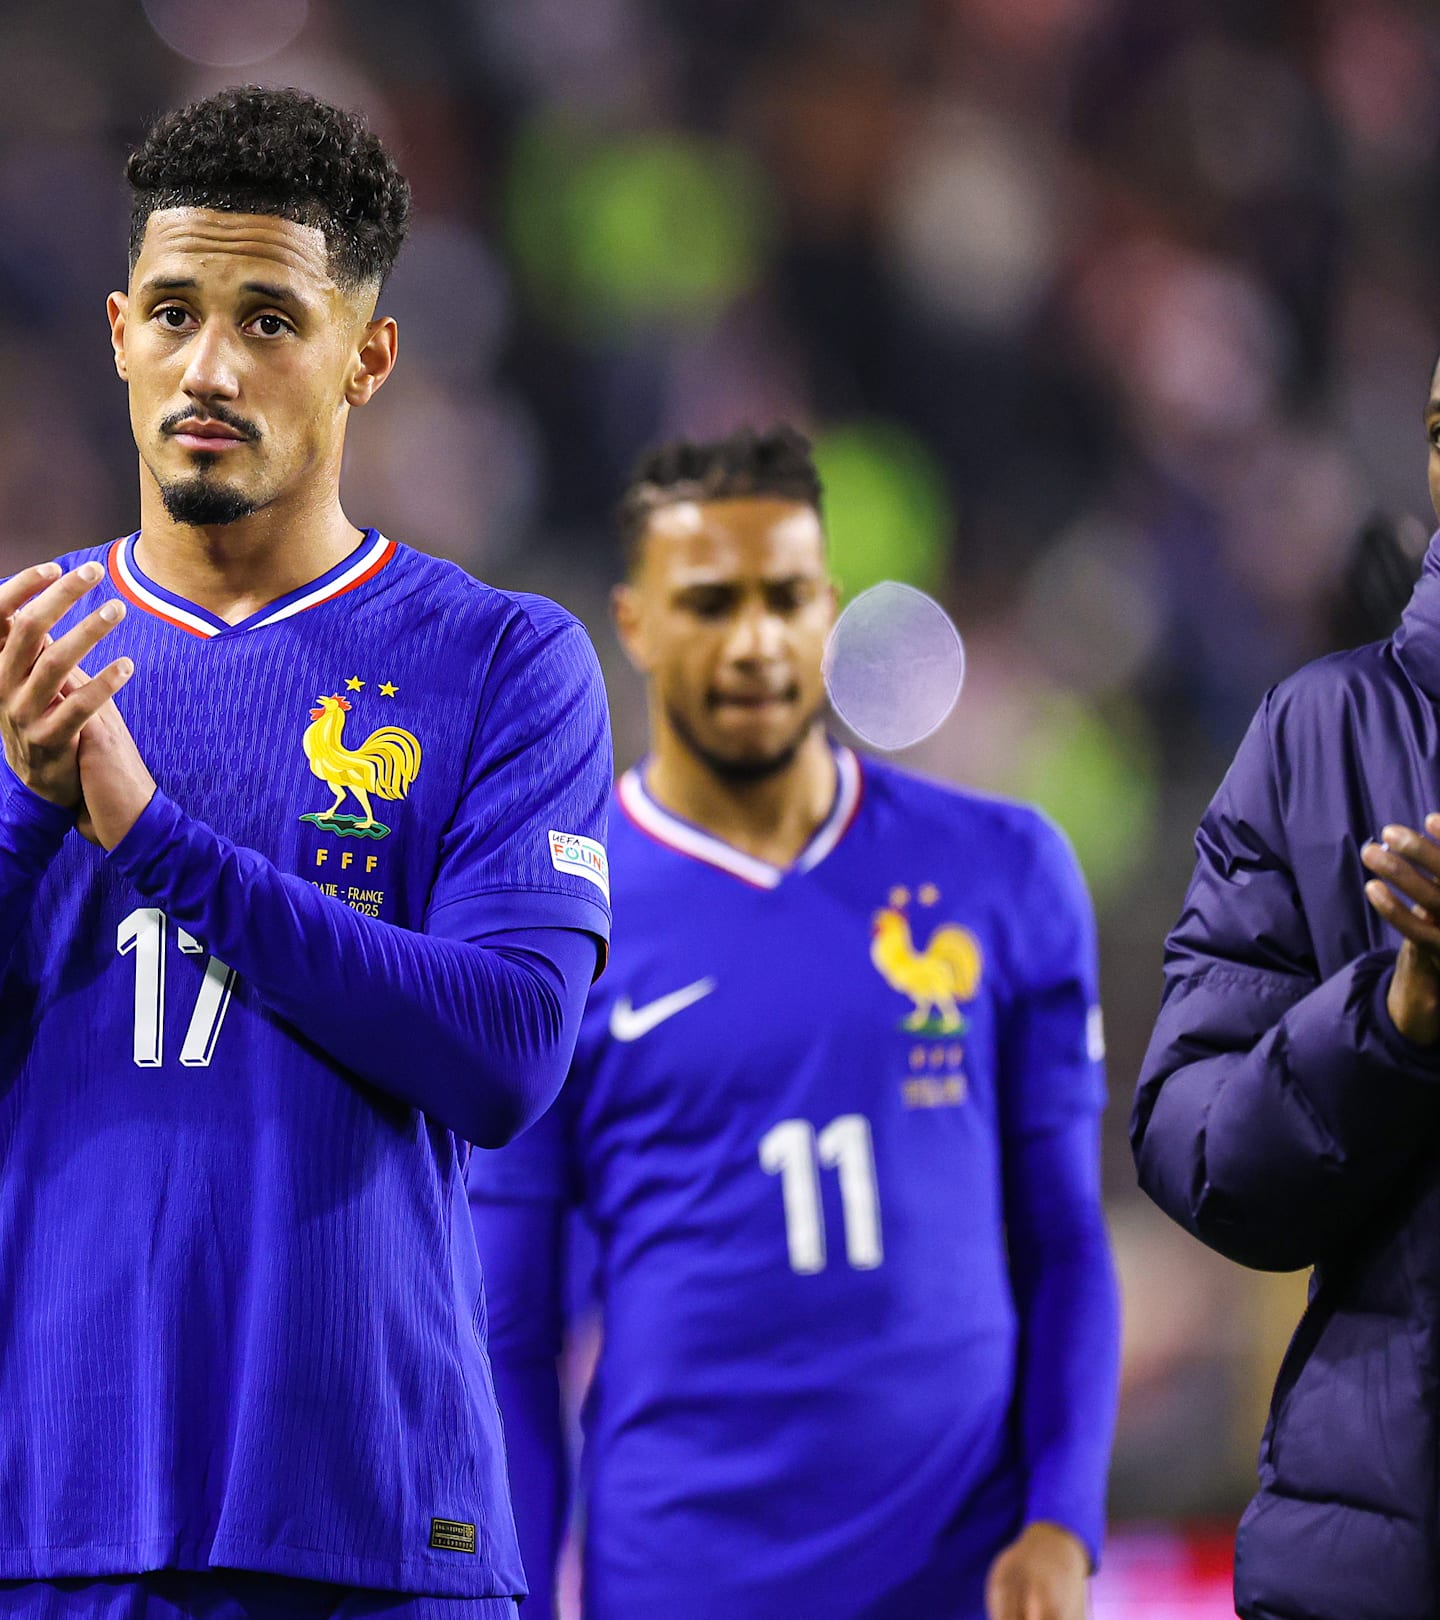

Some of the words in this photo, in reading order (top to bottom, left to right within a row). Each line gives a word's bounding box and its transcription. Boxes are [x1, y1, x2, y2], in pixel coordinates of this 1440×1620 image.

[552, 833, 580, 846] UEFA
[347, 886, 384, 904] FRANCE
[349, 901, 379, 917] 2025
[117, 908, 237, 1068] 17
[758, 1112, 885, 1276] 11
